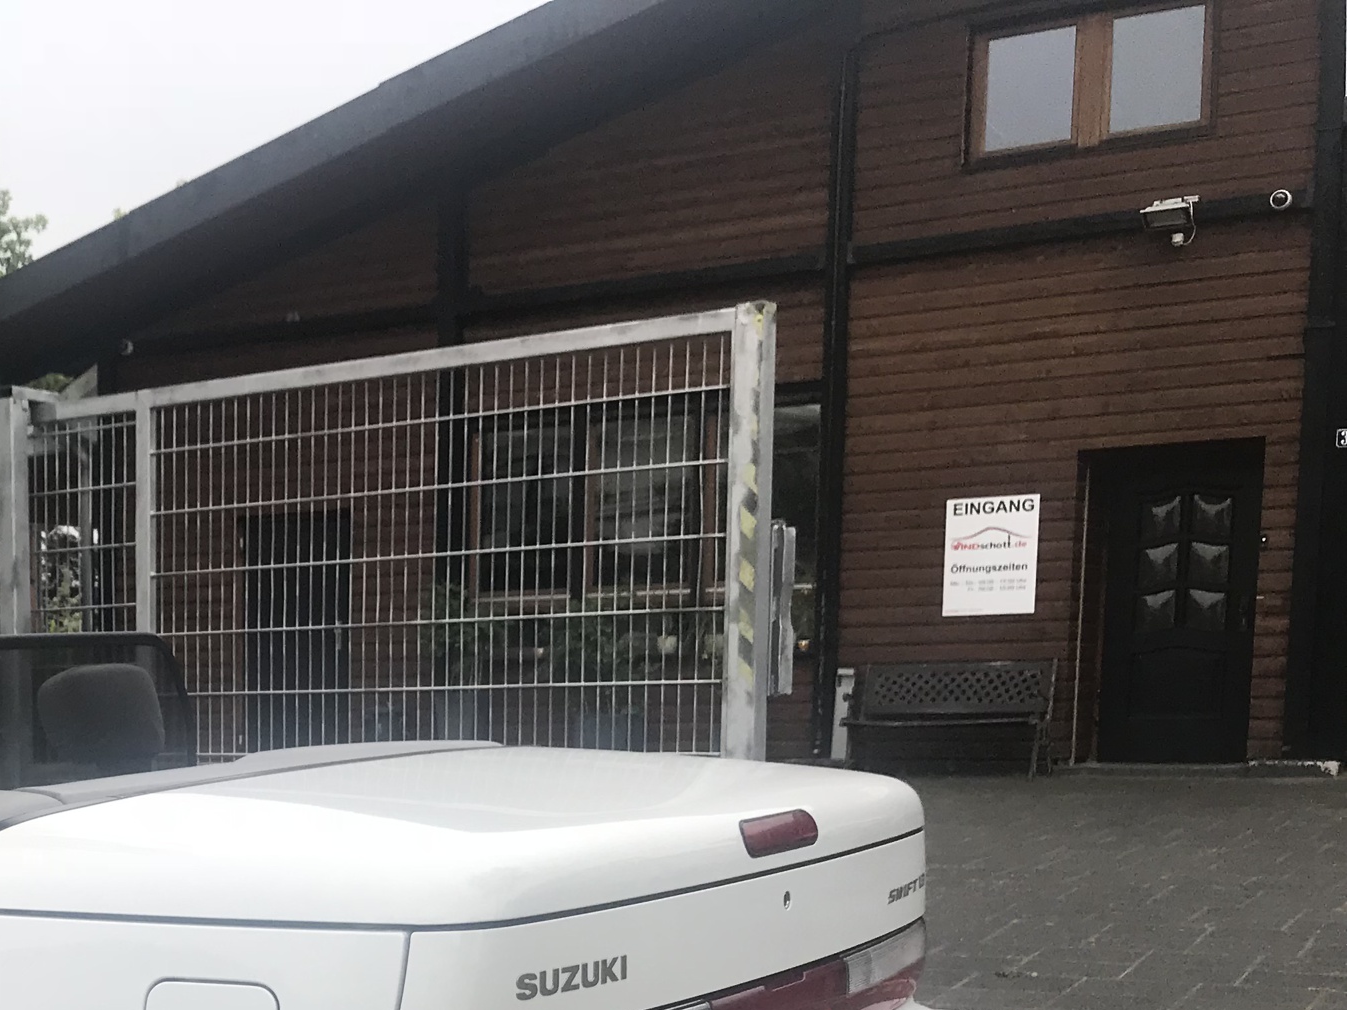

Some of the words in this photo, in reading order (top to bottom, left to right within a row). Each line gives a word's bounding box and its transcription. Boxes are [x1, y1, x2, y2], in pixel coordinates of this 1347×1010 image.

[953, 498, 1035, 516] EINGANG
[950, 562, 1028, 574] Öffnungszeiten
[887, 878, 918, 905] SWIFT
[515, 954, 627, 1001] SUZUKI
